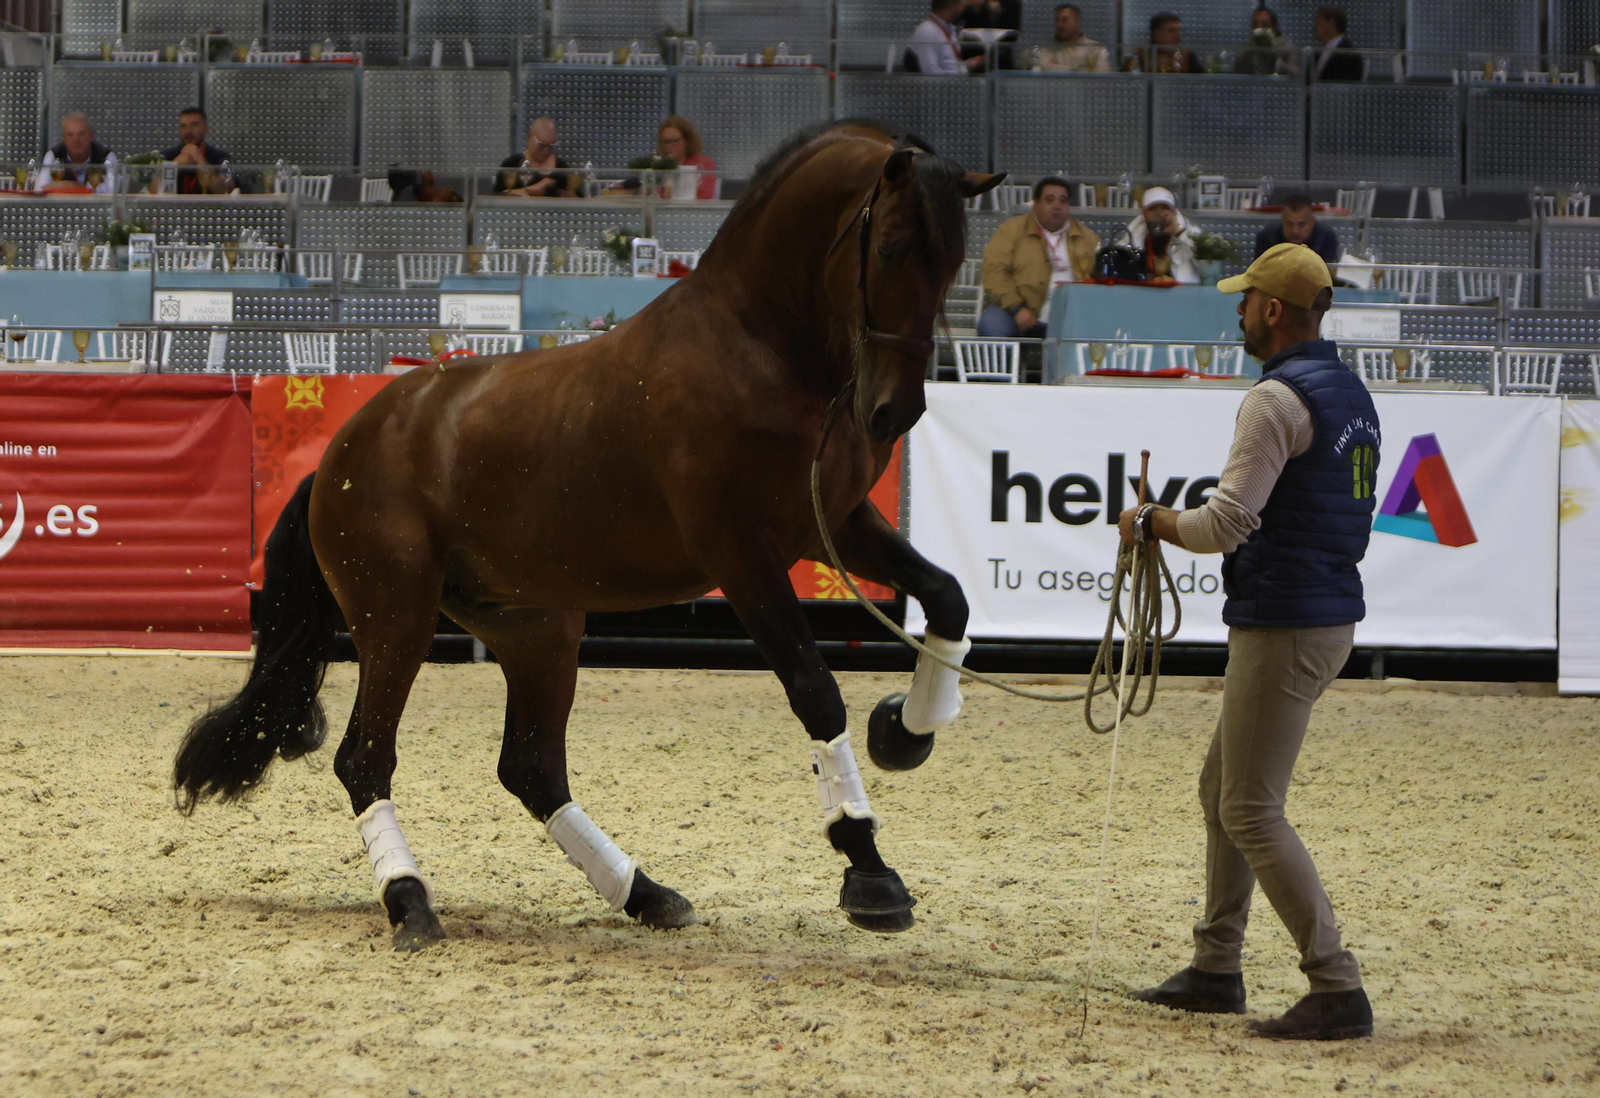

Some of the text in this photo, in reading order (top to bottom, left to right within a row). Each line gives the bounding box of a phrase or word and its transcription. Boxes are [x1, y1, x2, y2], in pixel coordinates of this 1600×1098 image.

[37, 445, 57, 456] en
[1334, 424, 1353, 454] FINCA
[1352, 417, 1363, 429] LAS
[34, 504, 99, 536] .es
[988, 558, 1022, 590] Tu
